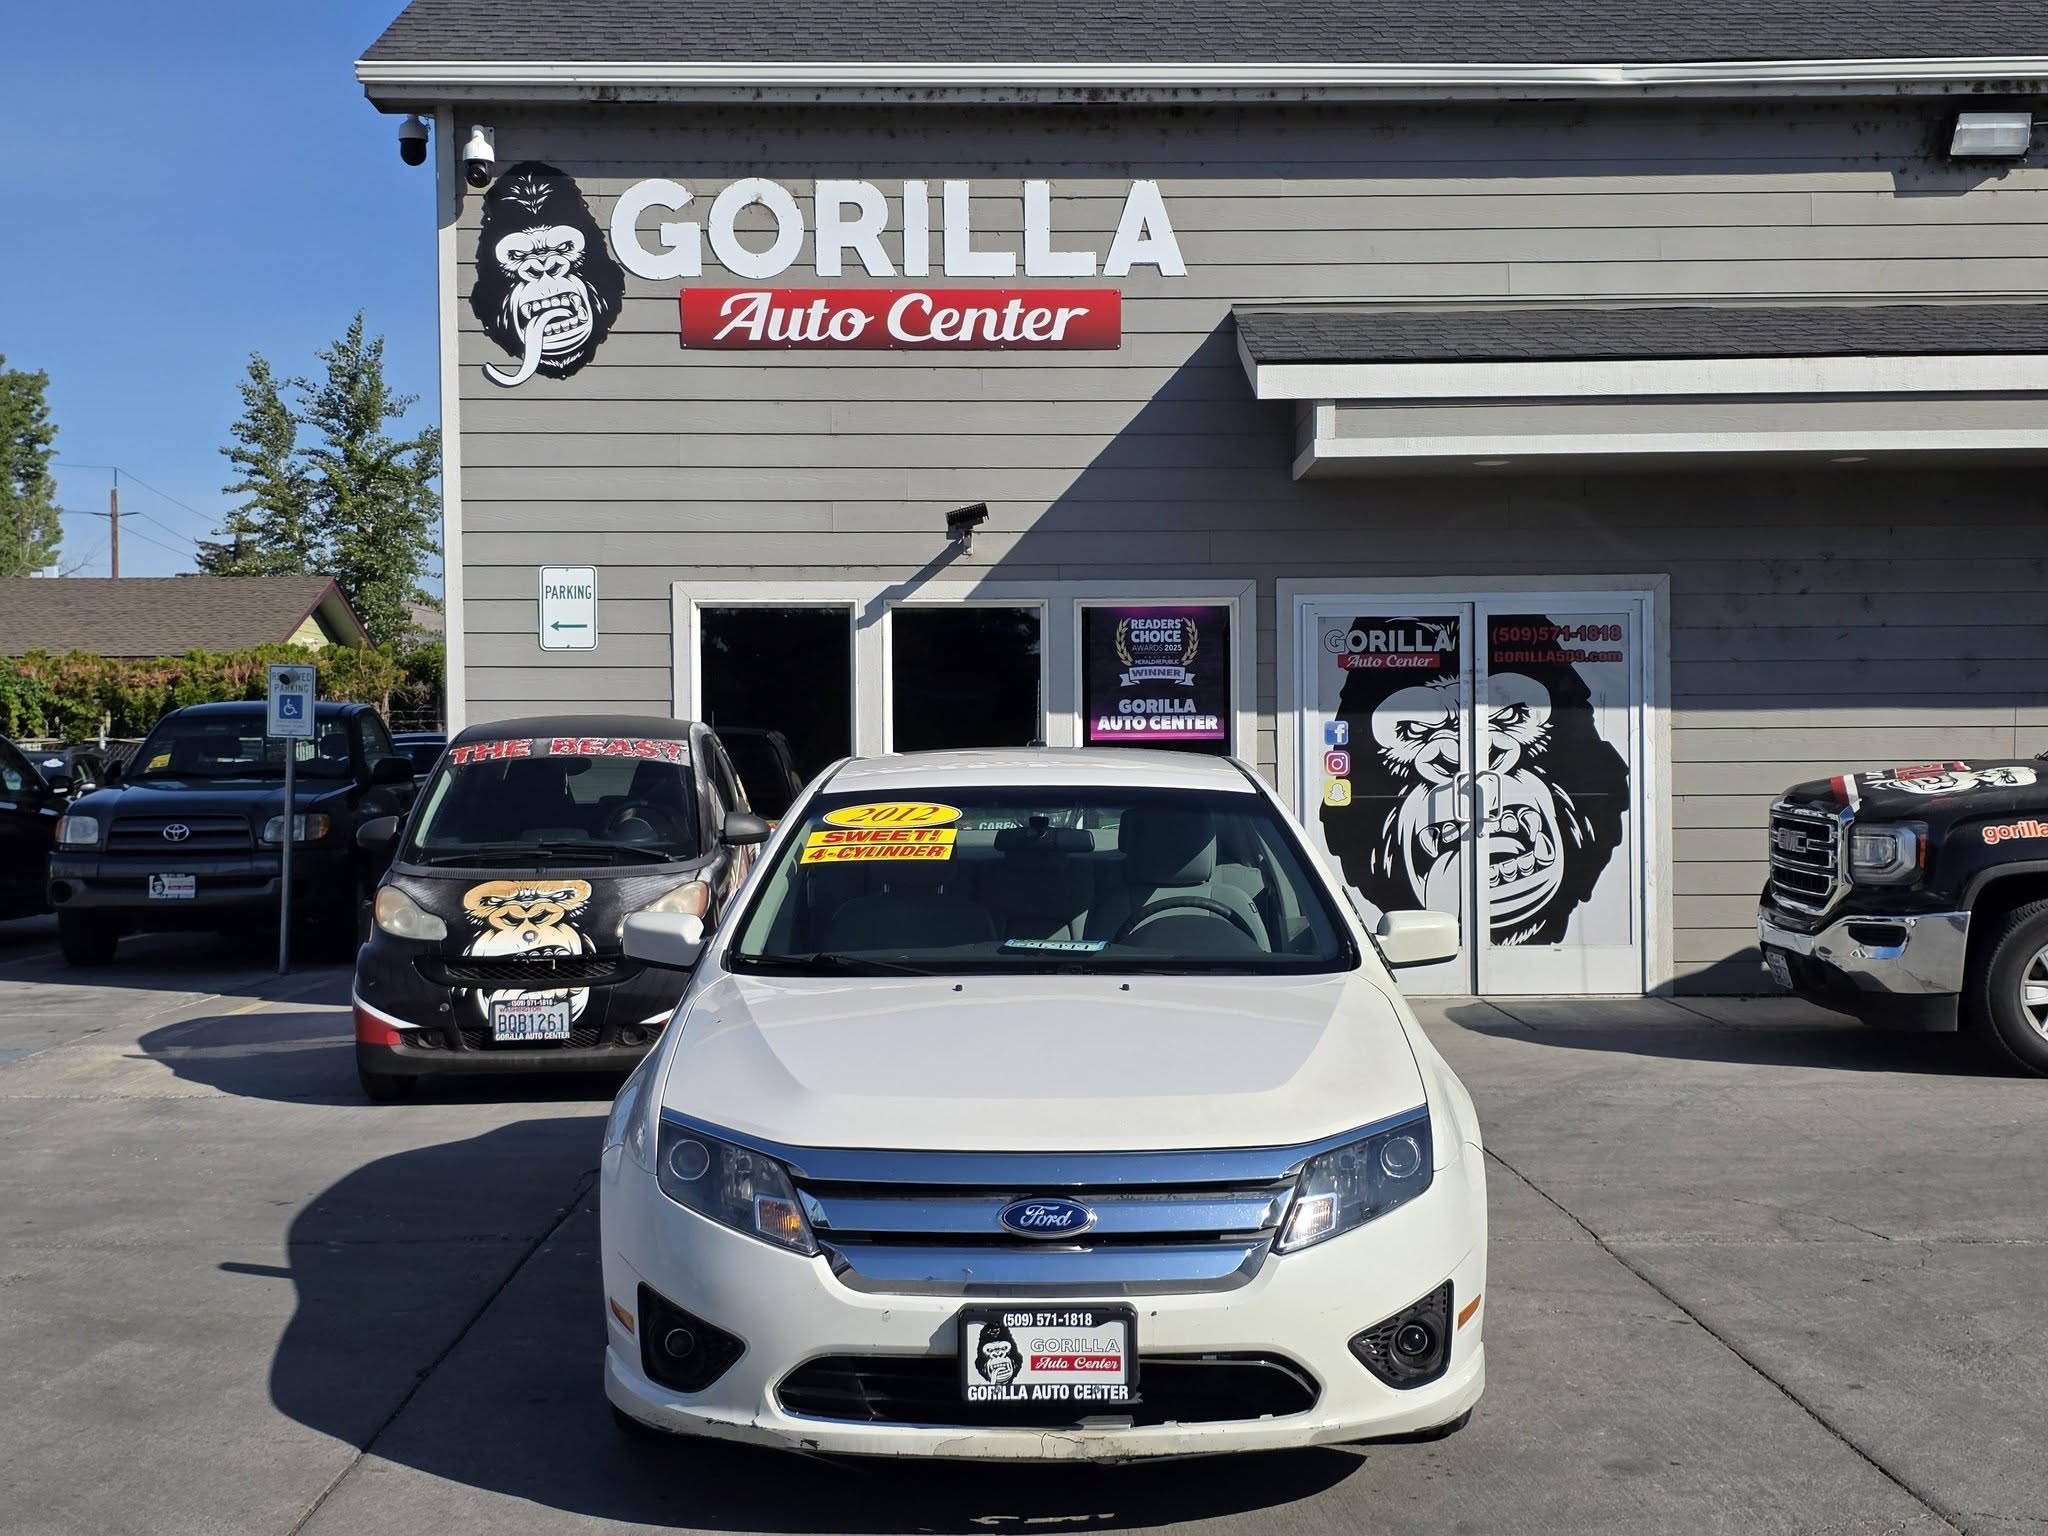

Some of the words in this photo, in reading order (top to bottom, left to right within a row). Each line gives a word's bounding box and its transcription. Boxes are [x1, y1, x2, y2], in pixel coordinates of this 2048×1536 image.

[610, 177, 1187, 279] GORILLA
[713, 292, 874, 341] Auto
[887, 292, 1090, 341] Center
[545, 585, 592, 599] PARKING
[1131, 630, 1182, 643] CHOICE
[1324, 629, 1453, 653] GORILLA
[1493, 625, 1622, 645] (509)571-1818
[1346, 655, 1383, 668] Auto
[1386, 654, 1432, 668] Center
[1494, 649, 1623, 663] GORILLA509.com
[1131, 668, 1181, 677] WINNER
[1118, 698, 1197, 714] GORILLA
[1097, 715, 1147, 731] AUTO
[1150, 715, 1218, 730] CENTER
[449, 738, 533, 765] THE
[549, 737, 689, 762] BEAST
[846, 806, 939, 823] 2012
[821, 830, 942, 843] SWEET!
[1982, 820, 2048, 845] gorilla
[808, 845, 947, 861] 4-CYLINDER
[498, 1013, 564, 1033] BQB1261
[525, 1032, 543, 1040] AUTO
[544, 1031, 570, 1039] CENTER
[1020, 1205, 1073, 1227] Ford
[1003, 1313, 1033, 1327] (509)
[1037, 1312, 1092, 1326] 571-1818
[1030, 1338, 1121, 1353] GORILLA
[1035, 1356, 1070, 1370] Auto
[1073, 1356, 1118, 1370] Center
[967, 1385, 1026, 1401] GORILLA
[1032, 1385, 1069, 1400] AUTO
[1074, 1384, 1129, 1400] CENTER
